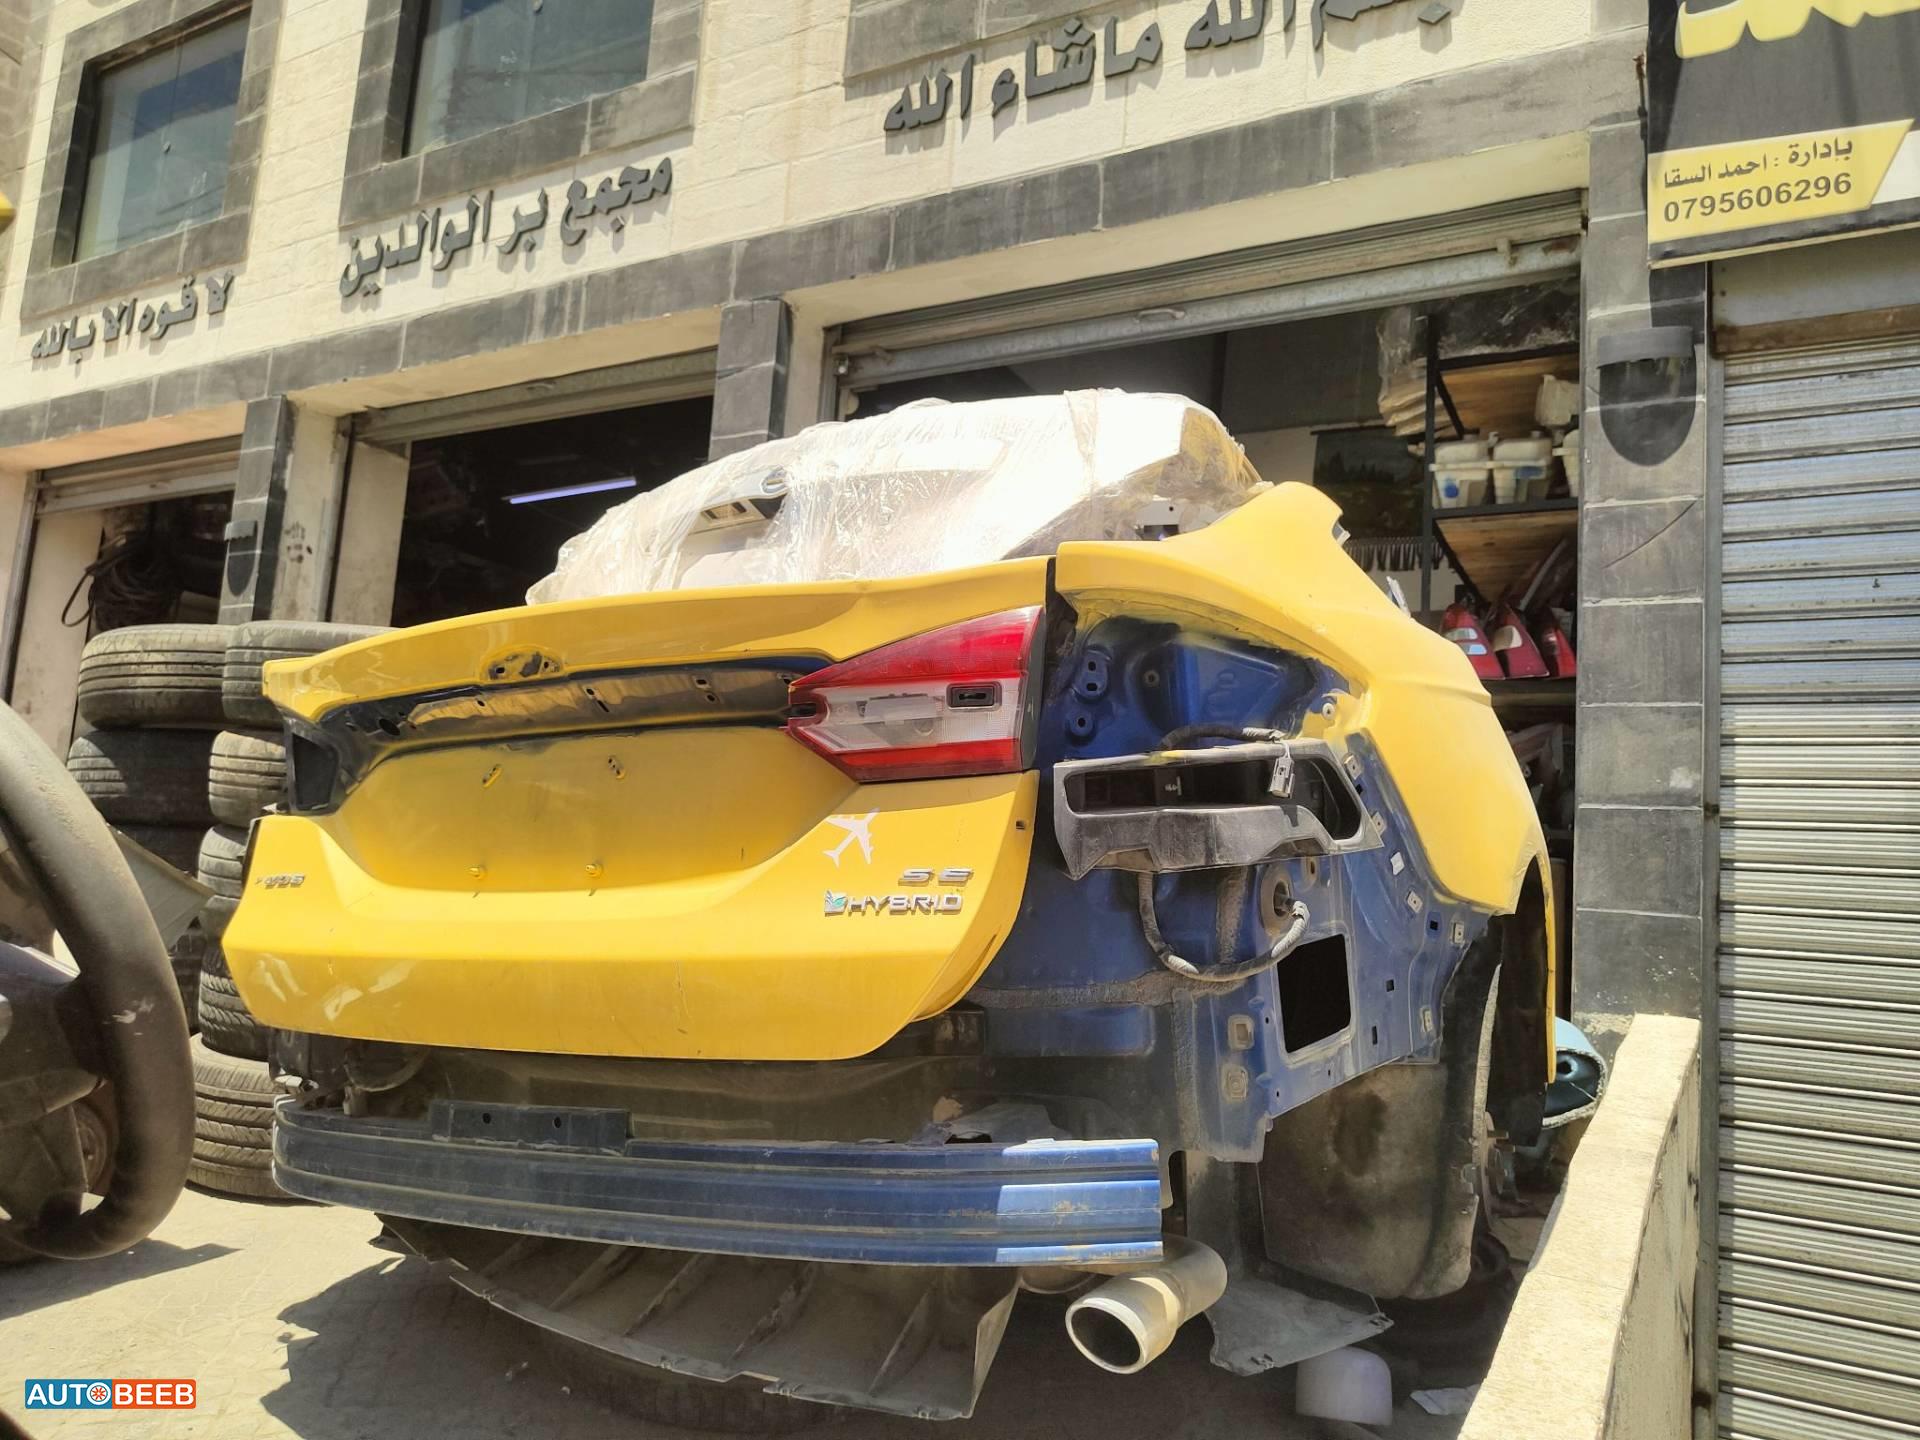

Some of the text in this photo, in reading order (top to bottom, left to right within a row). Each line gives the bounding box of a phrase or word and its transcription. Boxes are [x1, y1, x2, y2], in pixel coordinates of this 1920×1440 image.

[884, 54, 975, 131] الله
[1664, 163, 1711, 188] السقا
[1664, 173, 1852, 222] 0795606296
[340, 157, 672, 298] مجمع بر الوالدين
[206, 271, 234, 315] لا
[31, 315, 96, 364] بالله
[848, 893, 962, 915] HYBRID
